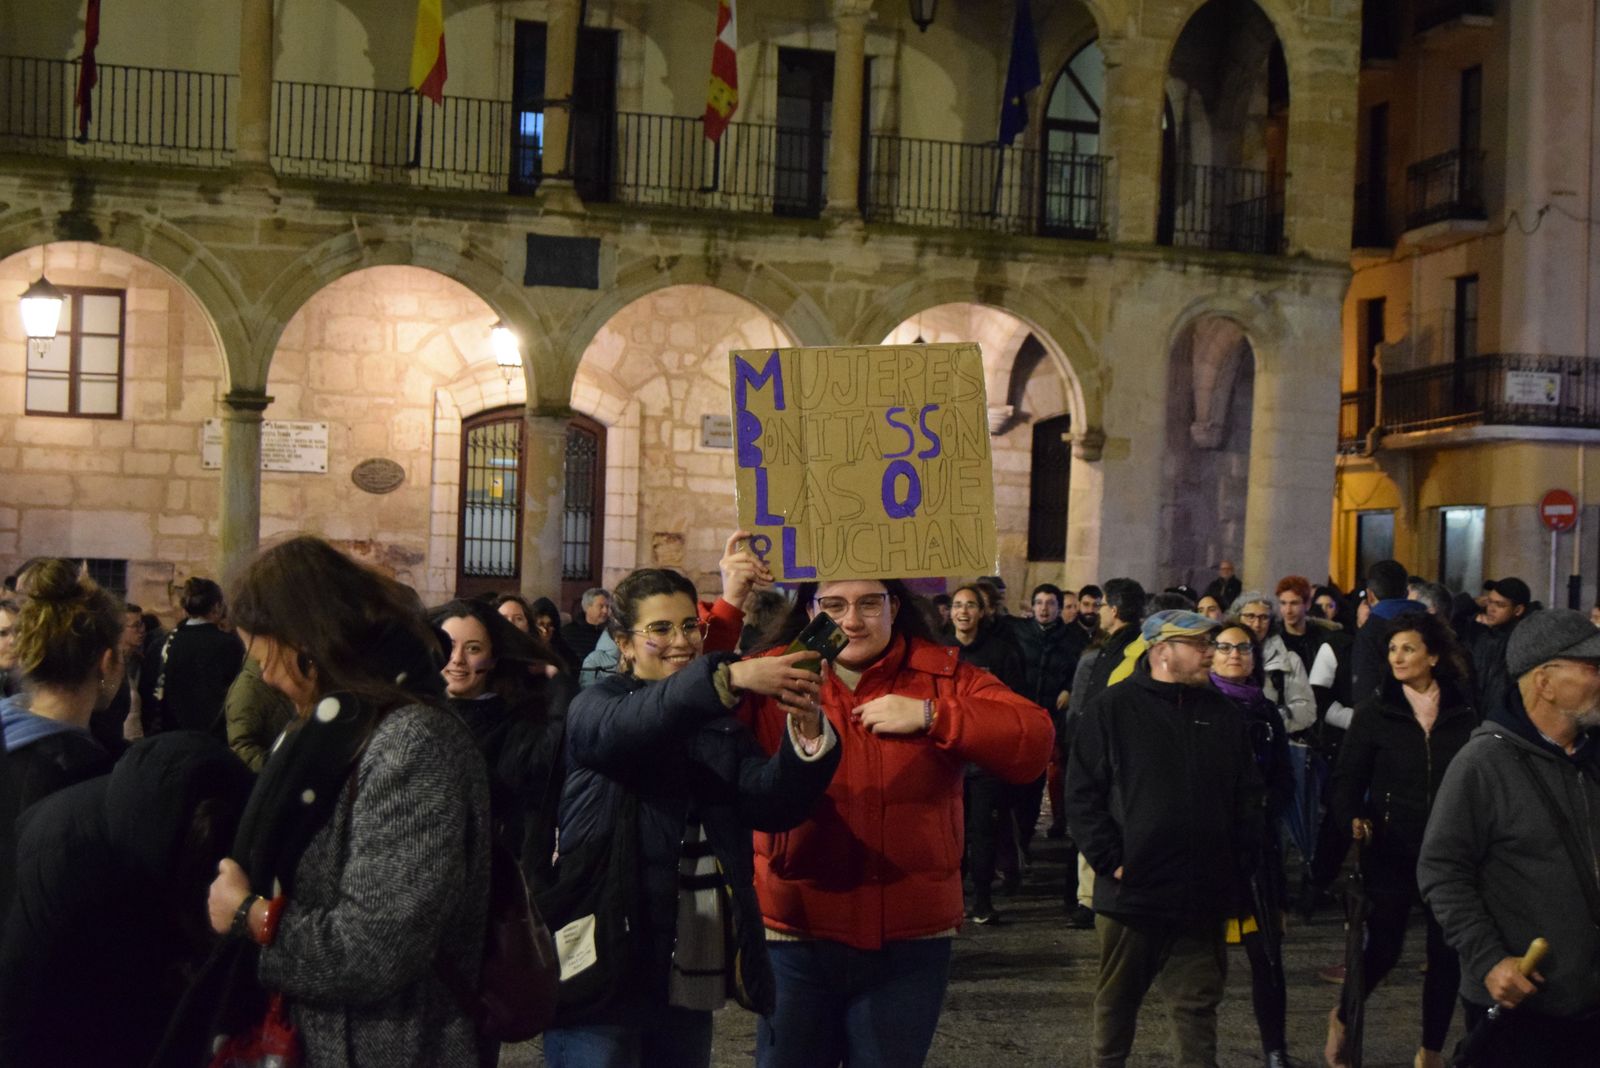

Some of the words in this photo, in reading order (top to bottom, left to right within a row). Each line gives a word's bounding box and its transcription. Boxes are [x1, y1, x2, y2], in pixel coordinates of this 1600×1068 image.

[735, 349, 983, 411] MUJERES
[736, 407, 915, 468] BONITAS
[918, 403, 987, 460] SON
[755, 460, 865, 526] LAS
[881, 458, 982, 519] QUE
[782, 518, 988, 579] LUCHAN
